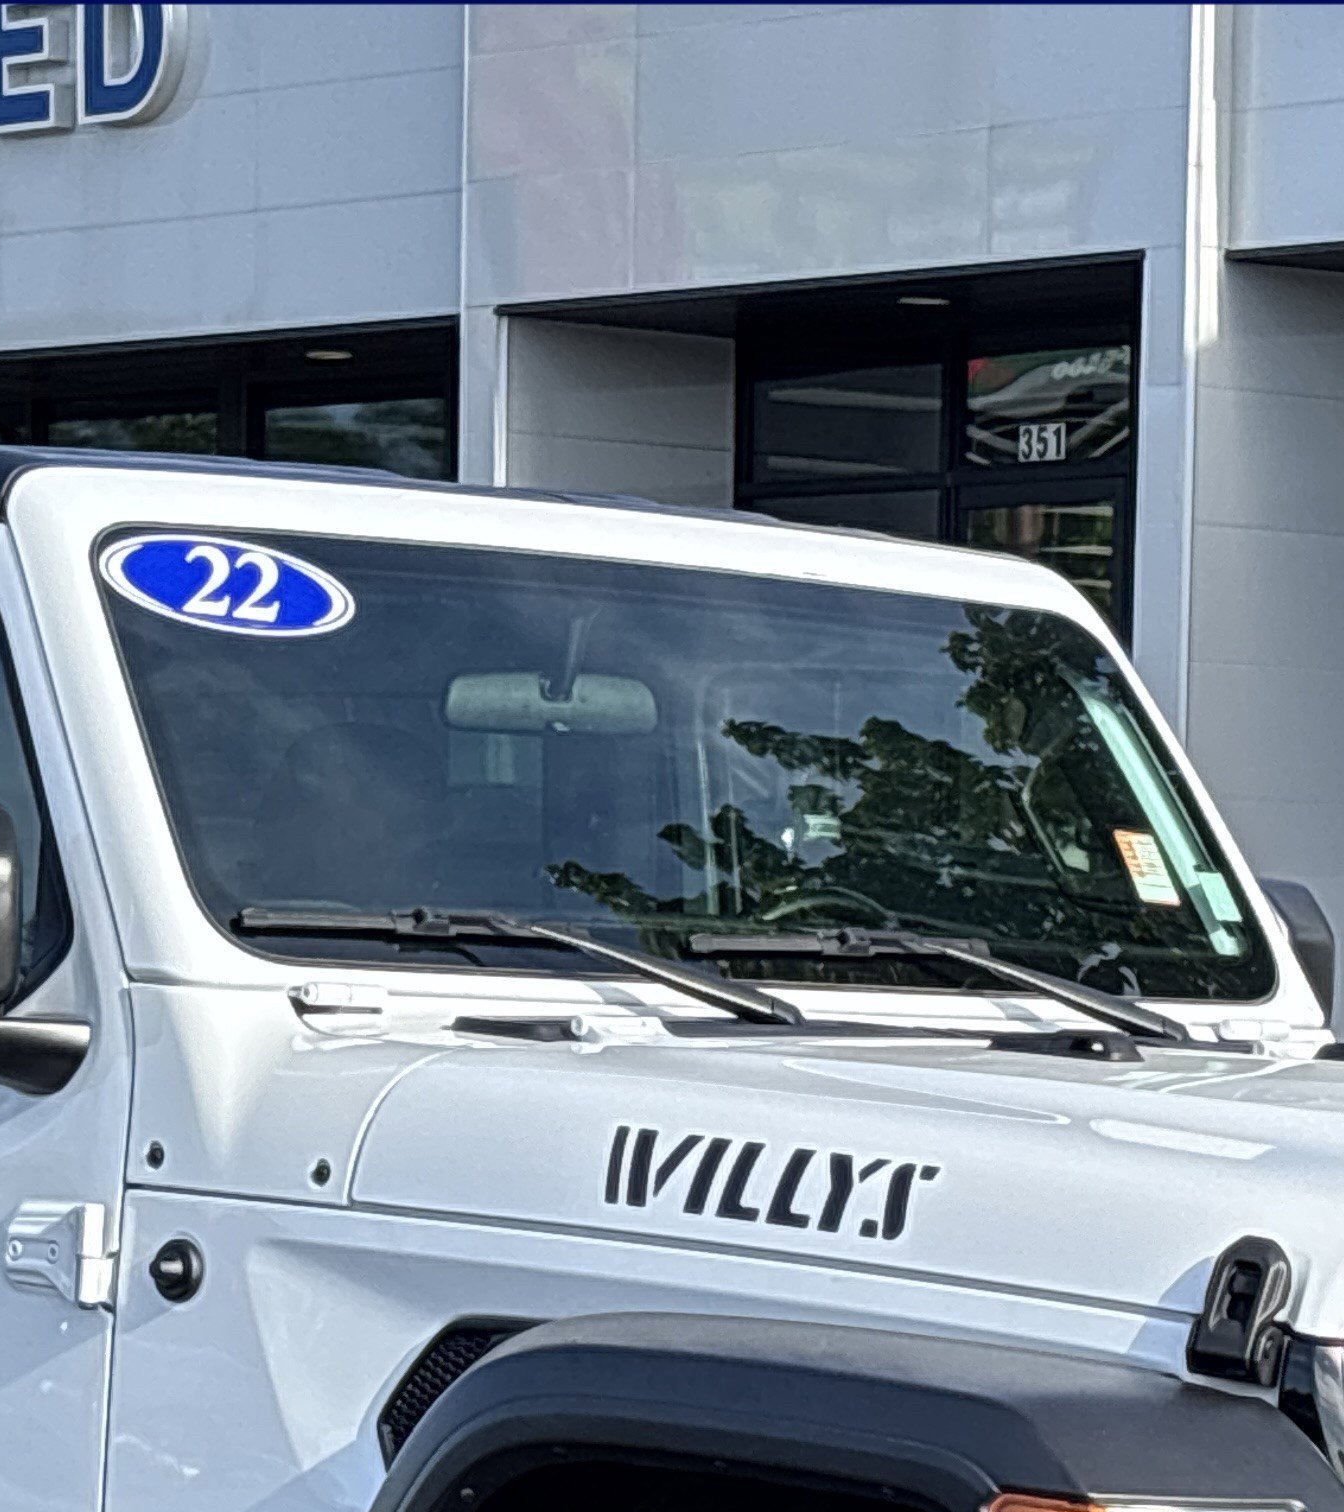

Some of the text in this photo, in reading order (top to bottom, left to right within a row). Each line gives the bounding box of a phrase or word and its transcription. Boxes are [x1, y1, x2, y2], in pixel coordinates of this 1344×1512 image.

[1020, 424, 1065, 460] 351
[181, 544, 281, 623] 22
[604, 1124, 941, 1241] WILLYS
